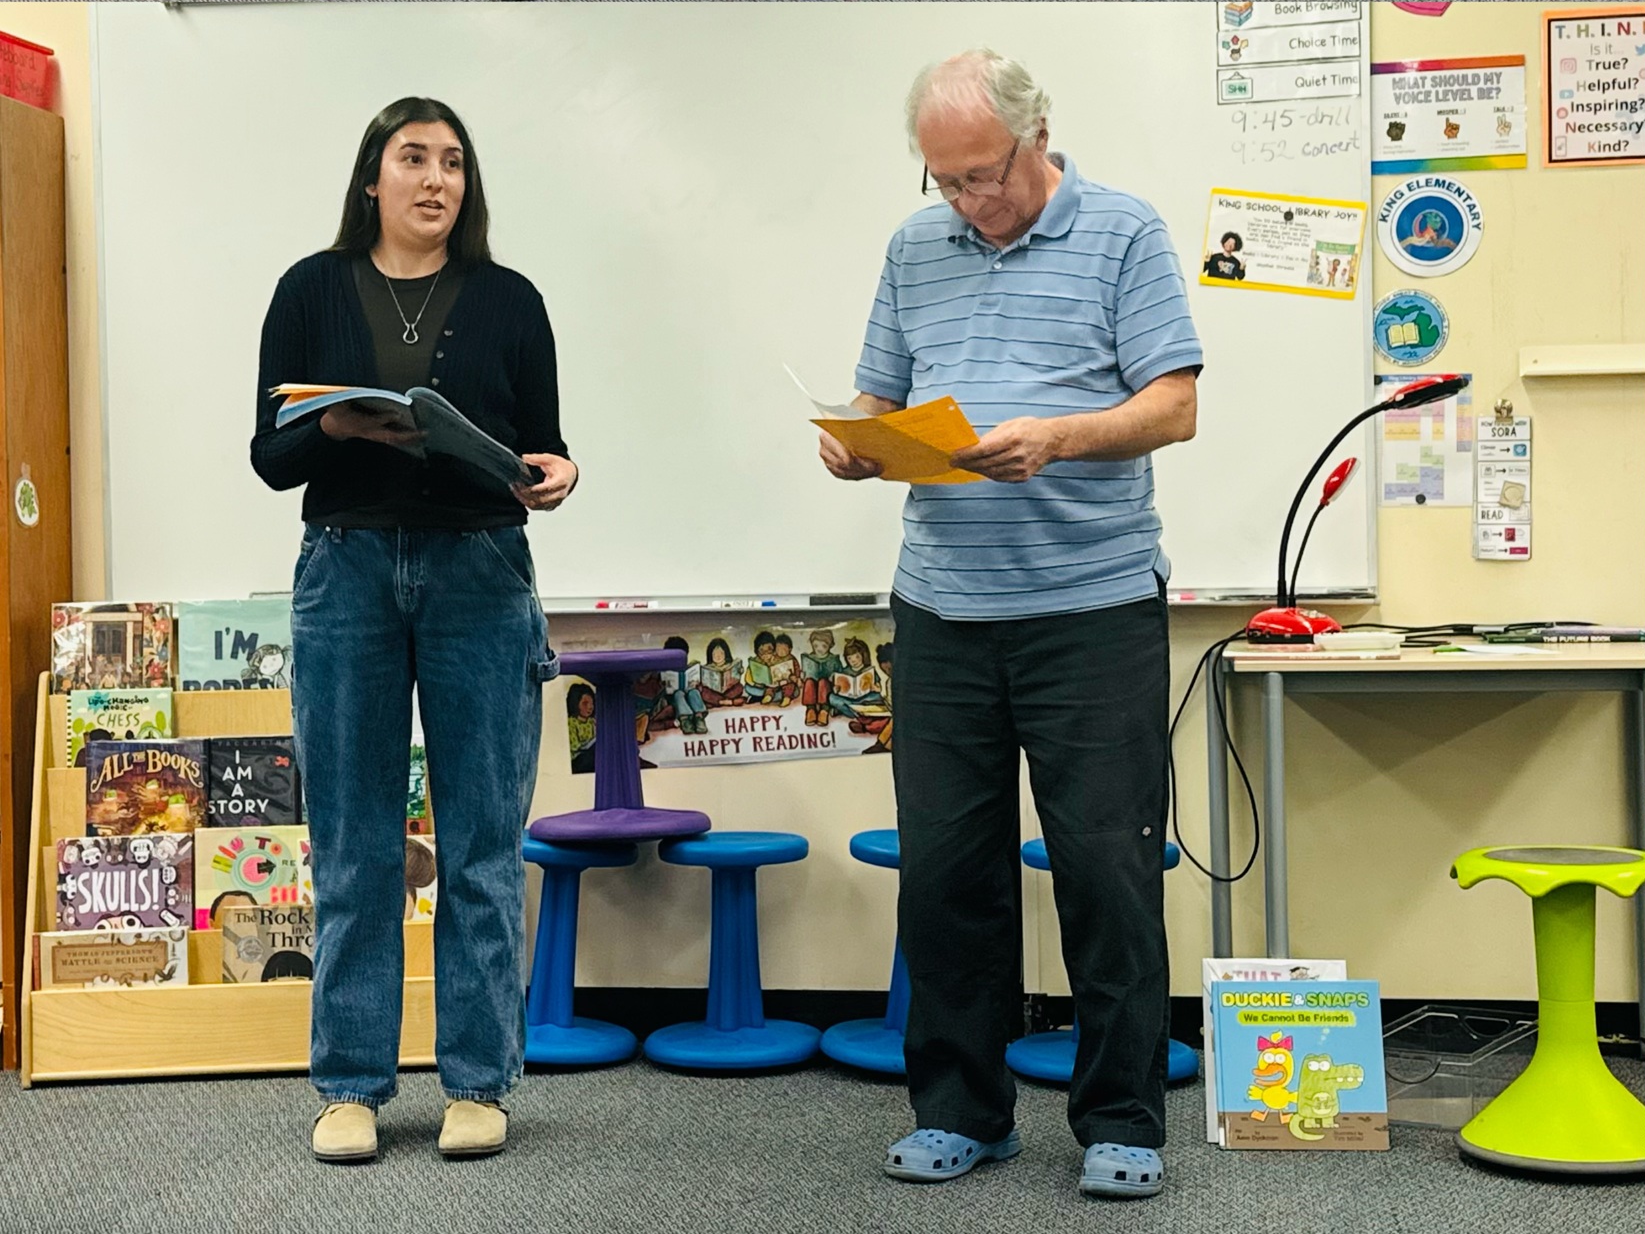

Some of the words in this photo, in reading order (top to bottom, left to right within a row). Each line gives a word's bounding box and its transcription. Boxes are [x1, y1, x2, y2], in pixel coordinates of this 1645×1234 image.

[1289, 38, 1326, 50] Choice
[1586, 58, 1628, 71] True?
[1295, 76, 1327, 88] Quiet
[1576, 77, 1639, 94] Helpful?
[1571, 98, 1645, 115] Inspiring?
[1588, 140, 1629, 153] Kind?
[1379, 188, 1405, 223] KING
[1407, 177, 1482, 232] ELEMENTARY
[1491, 427, 1517, 438] SORA
[215, 627, 259, 660] I'M
[97, 713, 140, 728] CHESS
[724, 715, 788, 735] HAPPY,
[683, 736, 744, 758] HAPPY
[752, 731, 837, 753] READING!
[91, 750, 133, 793] ALL
[146, 749, 204, 789] BOOKS
[222, 767, 252, 781] AM
[208, 798, 269, 815] STORY
[77, 868, 160, 914] SKULLS!
[1221, 992, 1293, 1008] DUCKIE
[1294, 994, 1305, 1006] &
[1306, 991, 1370, 1008] SNAPS
